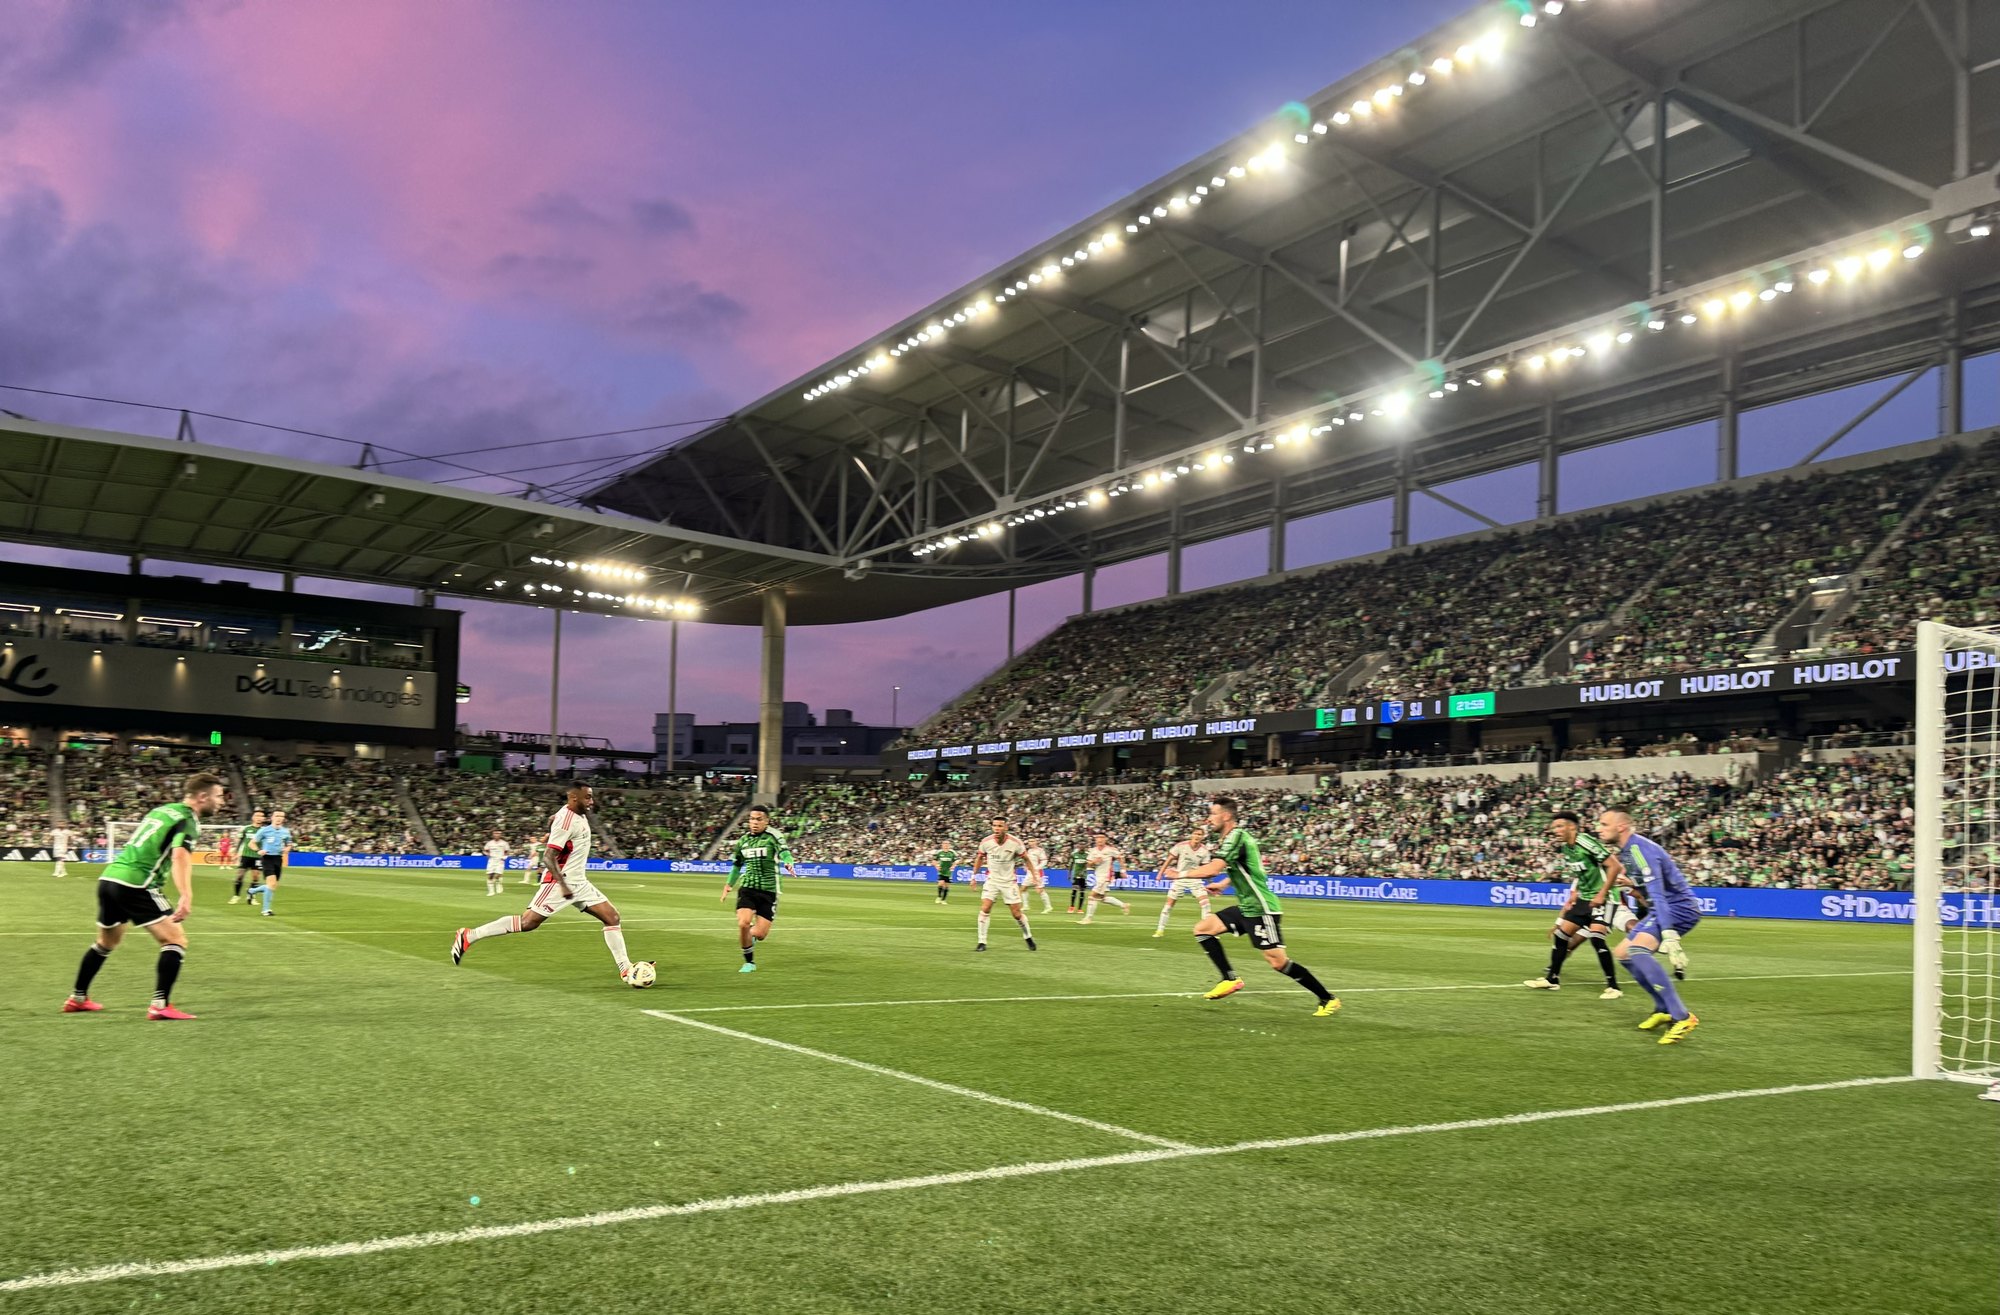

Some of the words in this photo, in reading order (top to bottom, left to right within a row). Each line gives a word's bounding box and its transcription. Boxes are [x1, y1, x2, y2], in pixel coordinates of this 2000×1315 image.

[1793, 658, 1901, 685] HUBLOT
[1579, 680, 1664, 702] HUBLOT
[1680, 669, 1775, 694] HUBLOT
[236, 675, 297, 697] DELL
[297, 680, 422, 708] Technologies
[1103, 729, 1146, 743] HUBLOT
[1152, 724, 1198, 739] HUBLOT
[1206, 719, 1256, 735] HUBLOT
[1058, 734, 1097, 748] HUBLOT
